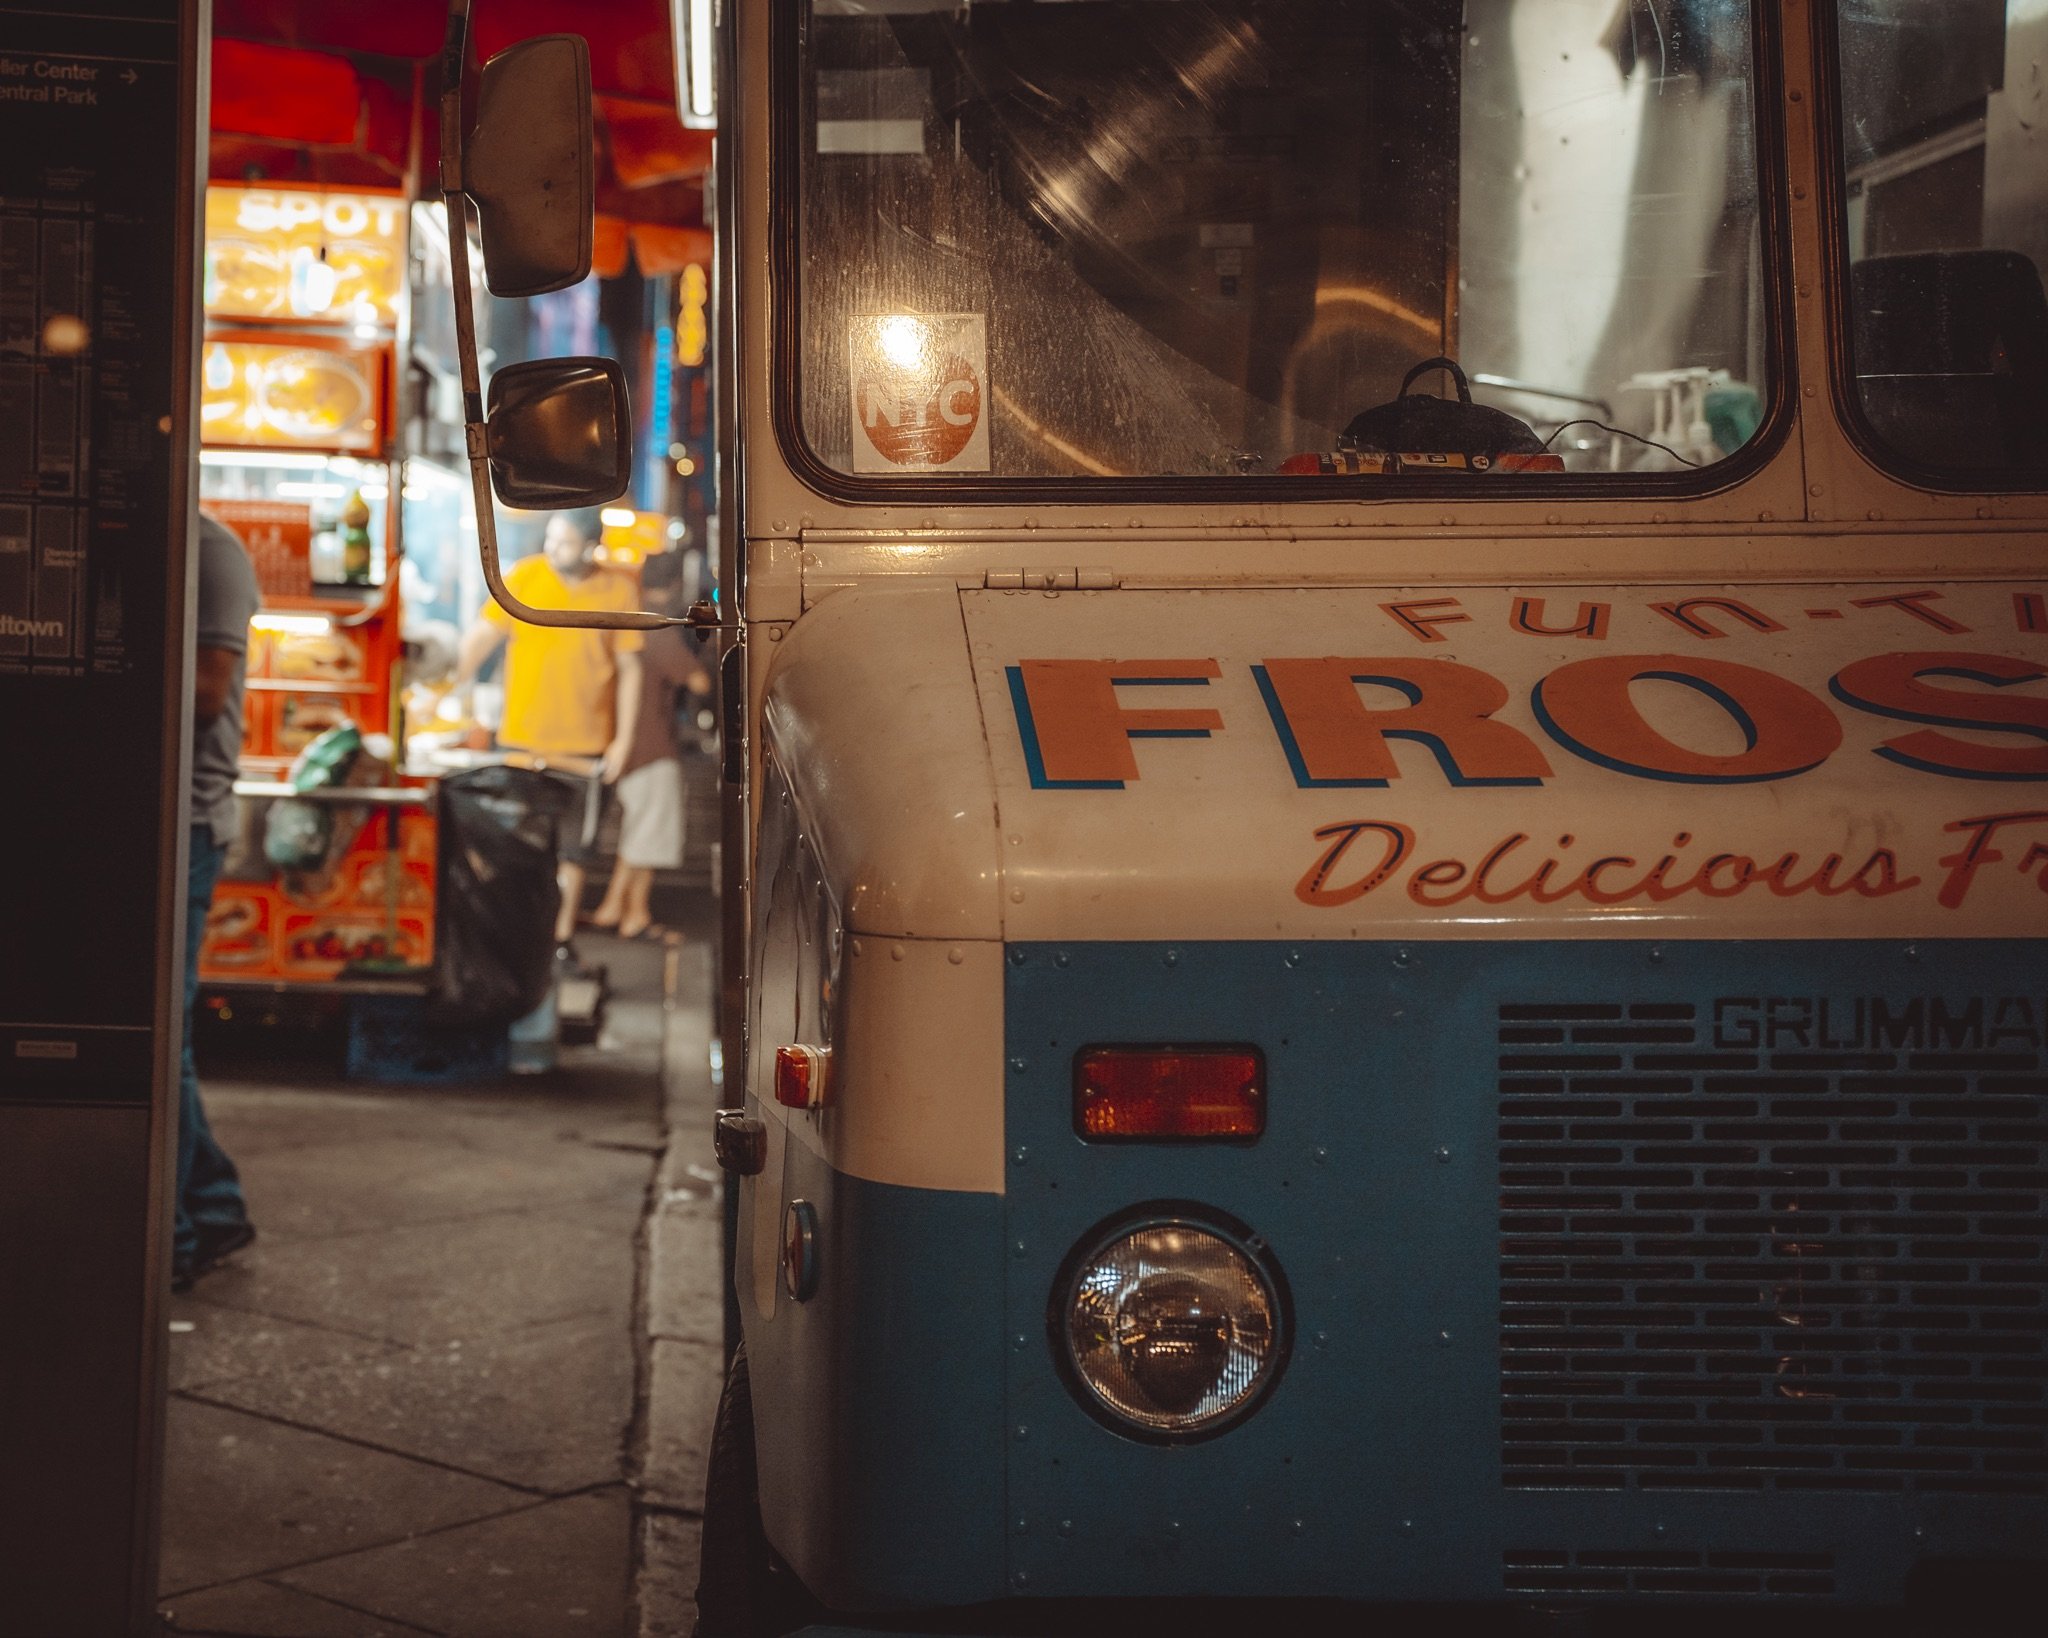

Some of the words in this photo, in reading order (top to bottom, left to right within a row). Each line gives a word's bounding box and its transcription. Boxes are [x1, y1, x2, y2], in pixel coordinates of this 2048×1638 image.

[33, 60, 99, 81] Center
[54, 86, 98, 105] Park
[236, 190, 403, 237] SPOT
[866, 380, 974, 428] NYC
[1005, 652, 2048, 790] FROS
[1295, 820, 1921, 908] Delicious
[1712, 997, 2041, 1050] GRUMMA
